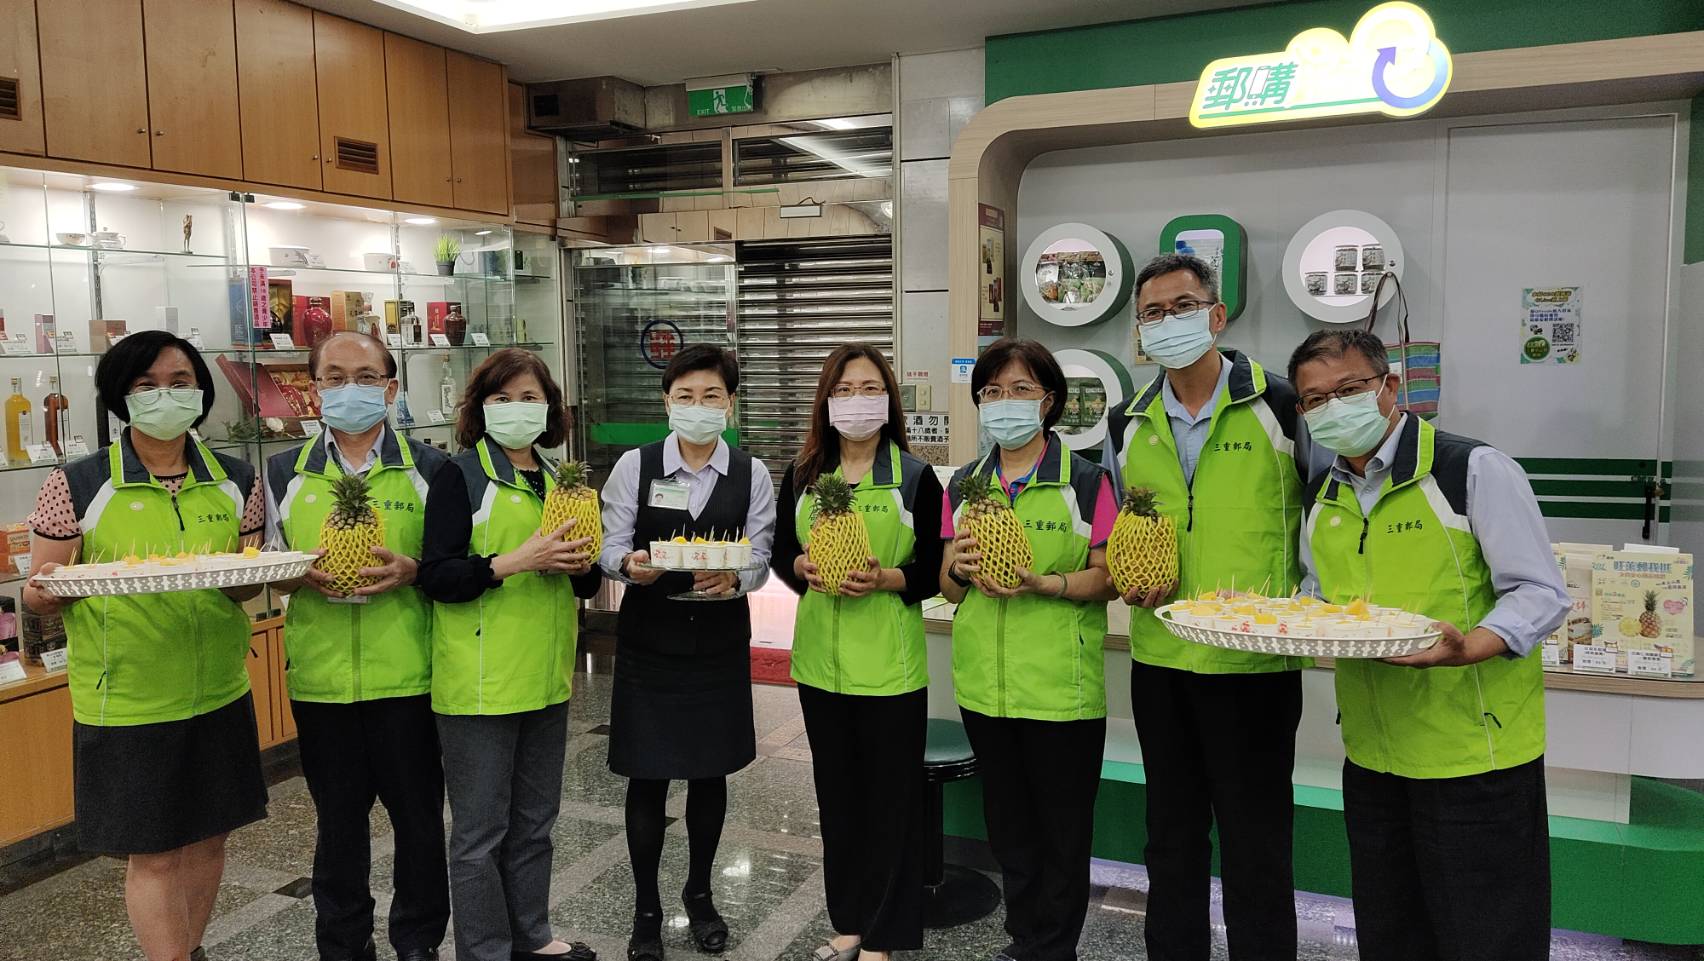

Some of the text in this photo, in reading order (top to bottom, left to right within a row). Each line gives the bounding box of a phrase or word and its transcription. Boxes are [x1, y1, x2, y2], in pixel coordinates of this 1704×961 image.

[1203, 61, 1298, 110] 郵購
[1213, 441, 1252, 451] 三重郵局
[372, 499, 414, 512] 三重郵局
[858, 504, 889, 513] 三重郵局
[197, 513, 230, 523] 三重郵局
[1023, 520, 1067, 532] 三重郵局
[1387, 519, 1423, 533] 三重郵局
